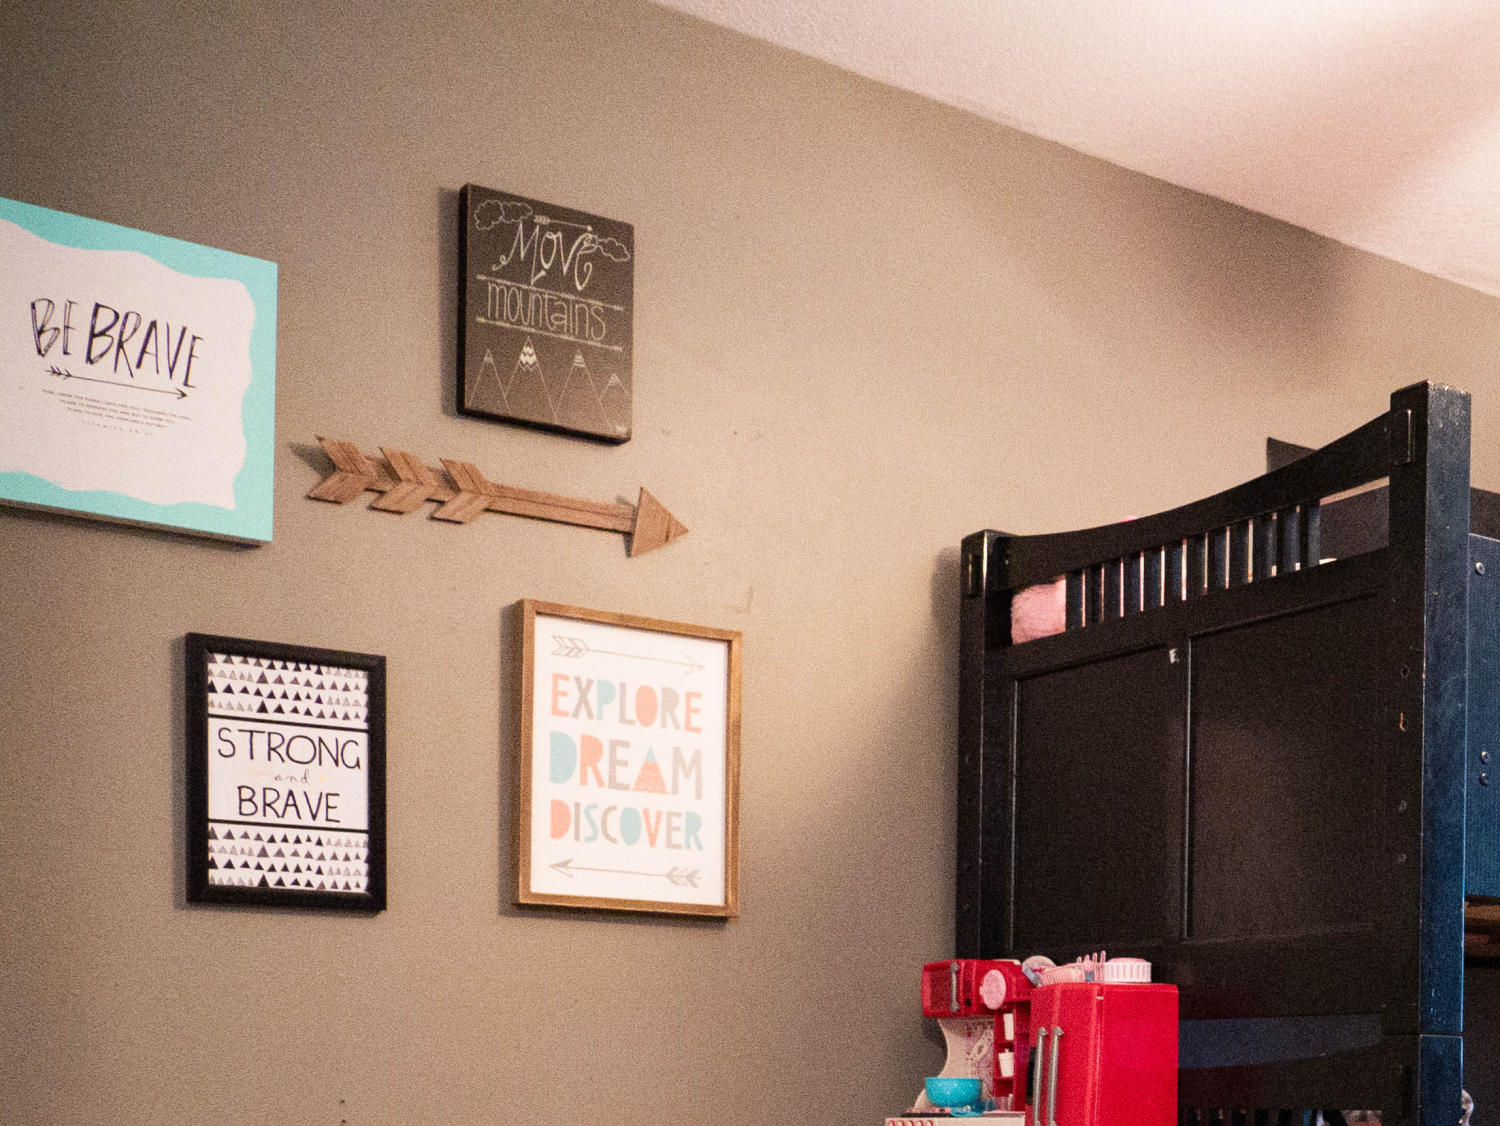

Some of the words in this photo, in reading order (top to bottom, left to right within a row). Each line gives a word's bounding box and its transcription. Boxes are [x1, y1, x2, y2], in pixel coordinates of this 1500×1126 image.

[487, 281, 606, 340] mountains
[30, 298, 79, 358] BE
[85, 302, 204, 388] BRAVE
[551, 673, 703, 734] EXPLORE
[217, 727, 360, 770] STRONG
[274, 768, 310, 784] and
[549, 731, 702, 800] DREAM
[237, 785, 340, 823] BRAVE
[549, 799, 703, 850] DISCOVER
